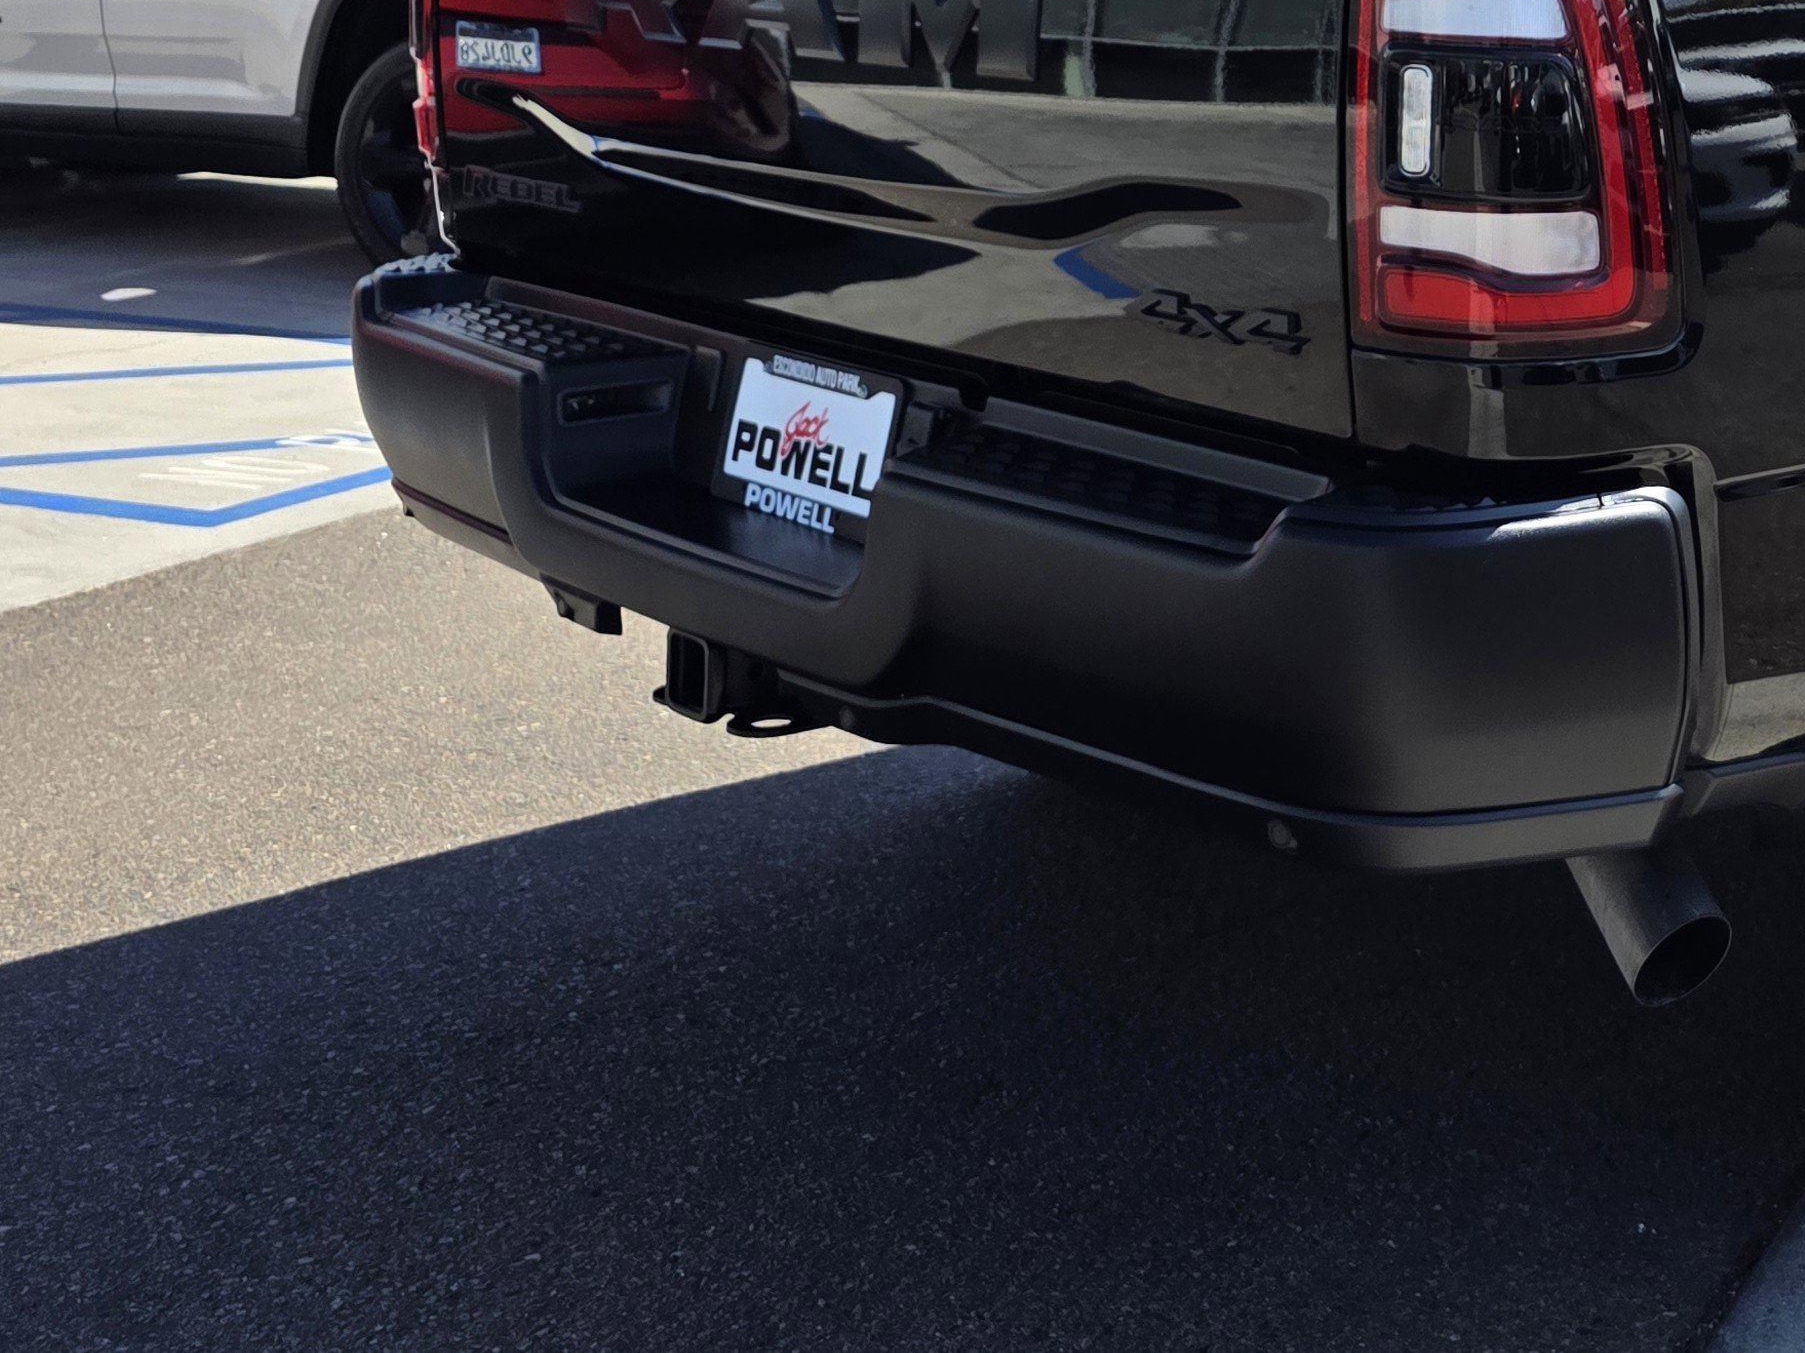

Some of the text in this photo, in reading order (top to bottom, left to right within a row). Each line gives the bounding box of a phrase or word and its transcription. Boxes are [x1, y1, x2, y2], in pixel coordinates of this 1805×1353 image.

[463, 164, 582, 213] REBEL
[815, 366, 838, 388] AUTO
[837, 371, 861, 394] PARK
[780, 400, 829, 459] Jack
[731, 418, 875, 496] POWELL
[744, 482, 836, 534] POWELL
